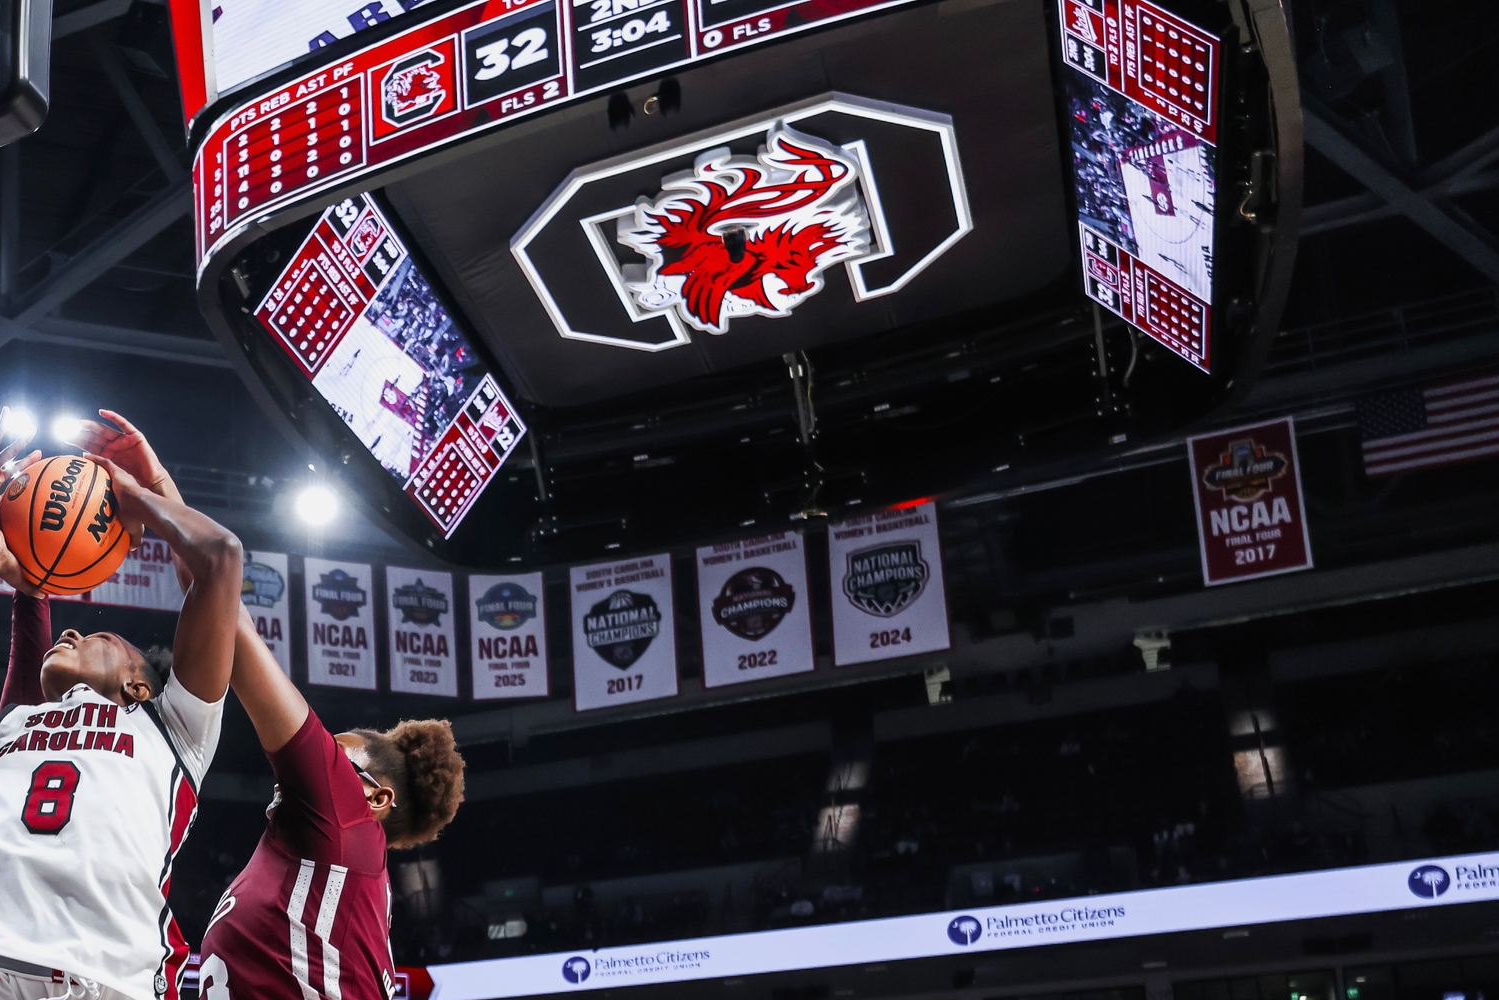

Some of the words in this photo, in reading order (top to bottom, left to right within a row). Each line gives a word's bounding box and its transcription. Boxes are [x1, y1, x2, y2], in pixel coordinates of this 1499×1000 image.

[590, 10, 671, 53] 3:04
[702, 30, 724, 48] 0
[733, 18, 772, 40] FLS
[1106, 17, 1117, 28] 0
[1125, 18, 1135, 40] AST
[1107, 44, 1119, 53] 2
[1108, 28, 1118, 44] FLS
[474, 27, 549, 82] 32
[1126, 58, 1136, 79] PTS
[230, 108, 257, 131] PTS
[260, 92, 291, 114] REB
[296, 74, 327, 97] AST
[333, 62, 354, 81] PF
[501, 91, 536, 114] FLS
[543, 81, 560, 100] 2
[216, 152, 222, 164] 1
[238, 134, 249, 147] 2
[270, 118, 281, 131] 2
[306, 101, 317, 114] 2
[340, 87, 348, 99] 1
[238, 148, 249, 162] 3
[272, 134, 280, 145] 1
[308, 117, 316, 129] 1
[338, 103, 351, 116] 0
[237, 164, 249, 178] 11
[270, 149, 282, 162] 0
[307, 132, 318, 146] 3
[340, 119, 349, 131] 1
[210, 200, 222, 219] 25
[238, 180, 249, 193] 4
[271, 164, 282, 178] 3
[306, 149, 318, 162] 2
[339, 135, 352, 149] 0
[209, 216, 222, 234] 30
[238, 196, 249, 209] 0
[270, 181, 282, 194] 0
[306, 165, 319, 178] 0
[339, 152, 352, 165] 0
[40, 459, 87, 532] Wilson
[1210, 497, 1292, 537] NCAA
[854, 551, 914, 573] NATIONAL
[1235, 544, 1276, 566] 2017
[849, 565, 922, 590] CHAMPIONS
[587, 606, 657, 631] NATIONAL
[720, 597, 788, 619] CHAMPIONS
[313, 623, 368, 650] NCAA
[395, 630, 449, 658] NCAA
[589, 622, 657, 646] CHAMPIONS
[869, 627, 912, 649] 2024
[478, 635, 539, 660] NCAA
[738, 649, 778, 670] 2022
[328, 662, 356, 677] 2021
[409, 669, 438, 684] 2023
[494, 674, 526, 688] 2025
[607, 674, 643, 695] 2017
[25, 702, 118, 729] SOUTH
[21, 760, 81, 835] 8
[986, 914, 1058, 930] Palmetto
[1060, 905, 1126, 923] Citizens
[595, 956, 654, 970] Palmetto
[656, 950, 710, 965] Citizens
